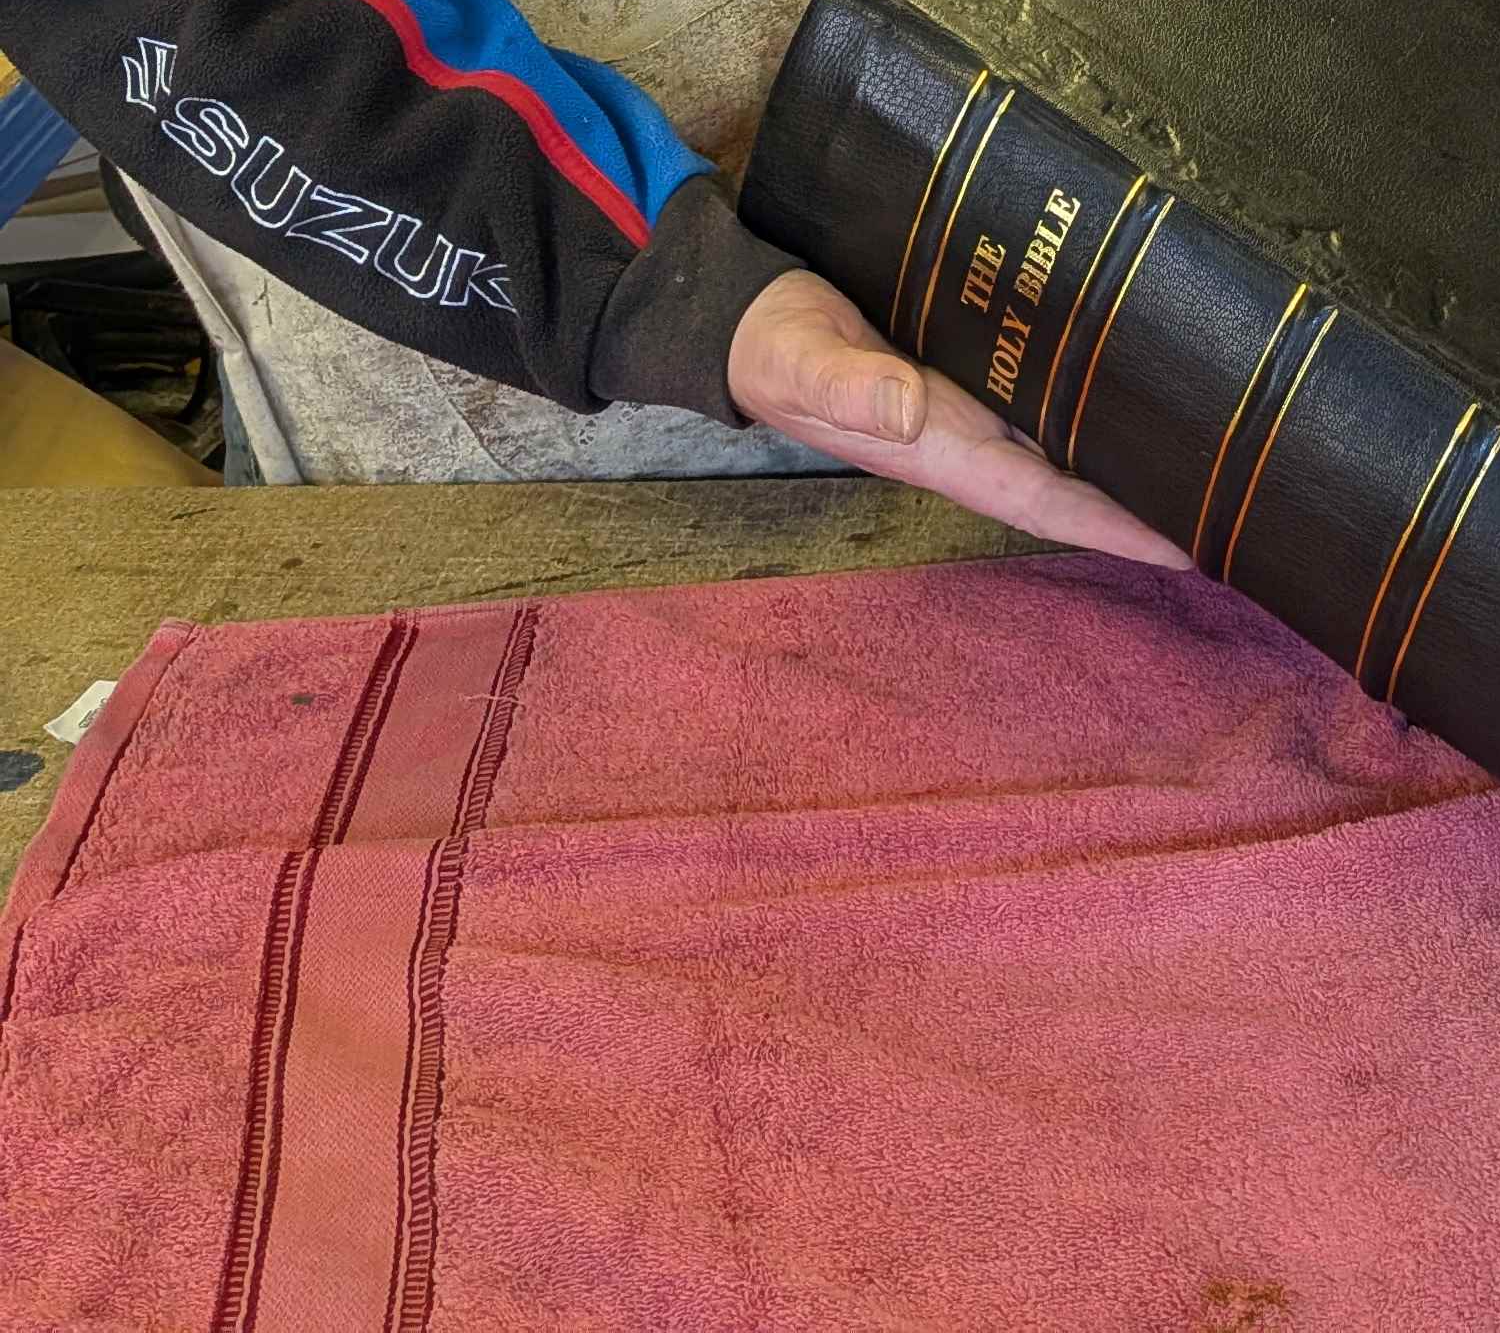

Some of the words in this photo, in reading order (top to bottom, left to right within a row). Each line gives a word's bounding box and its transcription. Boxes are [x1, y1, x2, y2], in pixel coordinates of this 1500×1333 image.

[960, 234, 1007, 315] THE
[986, 305, 1032, 405] HOLY
[1013, 187, 1081, 307] BIBLE
